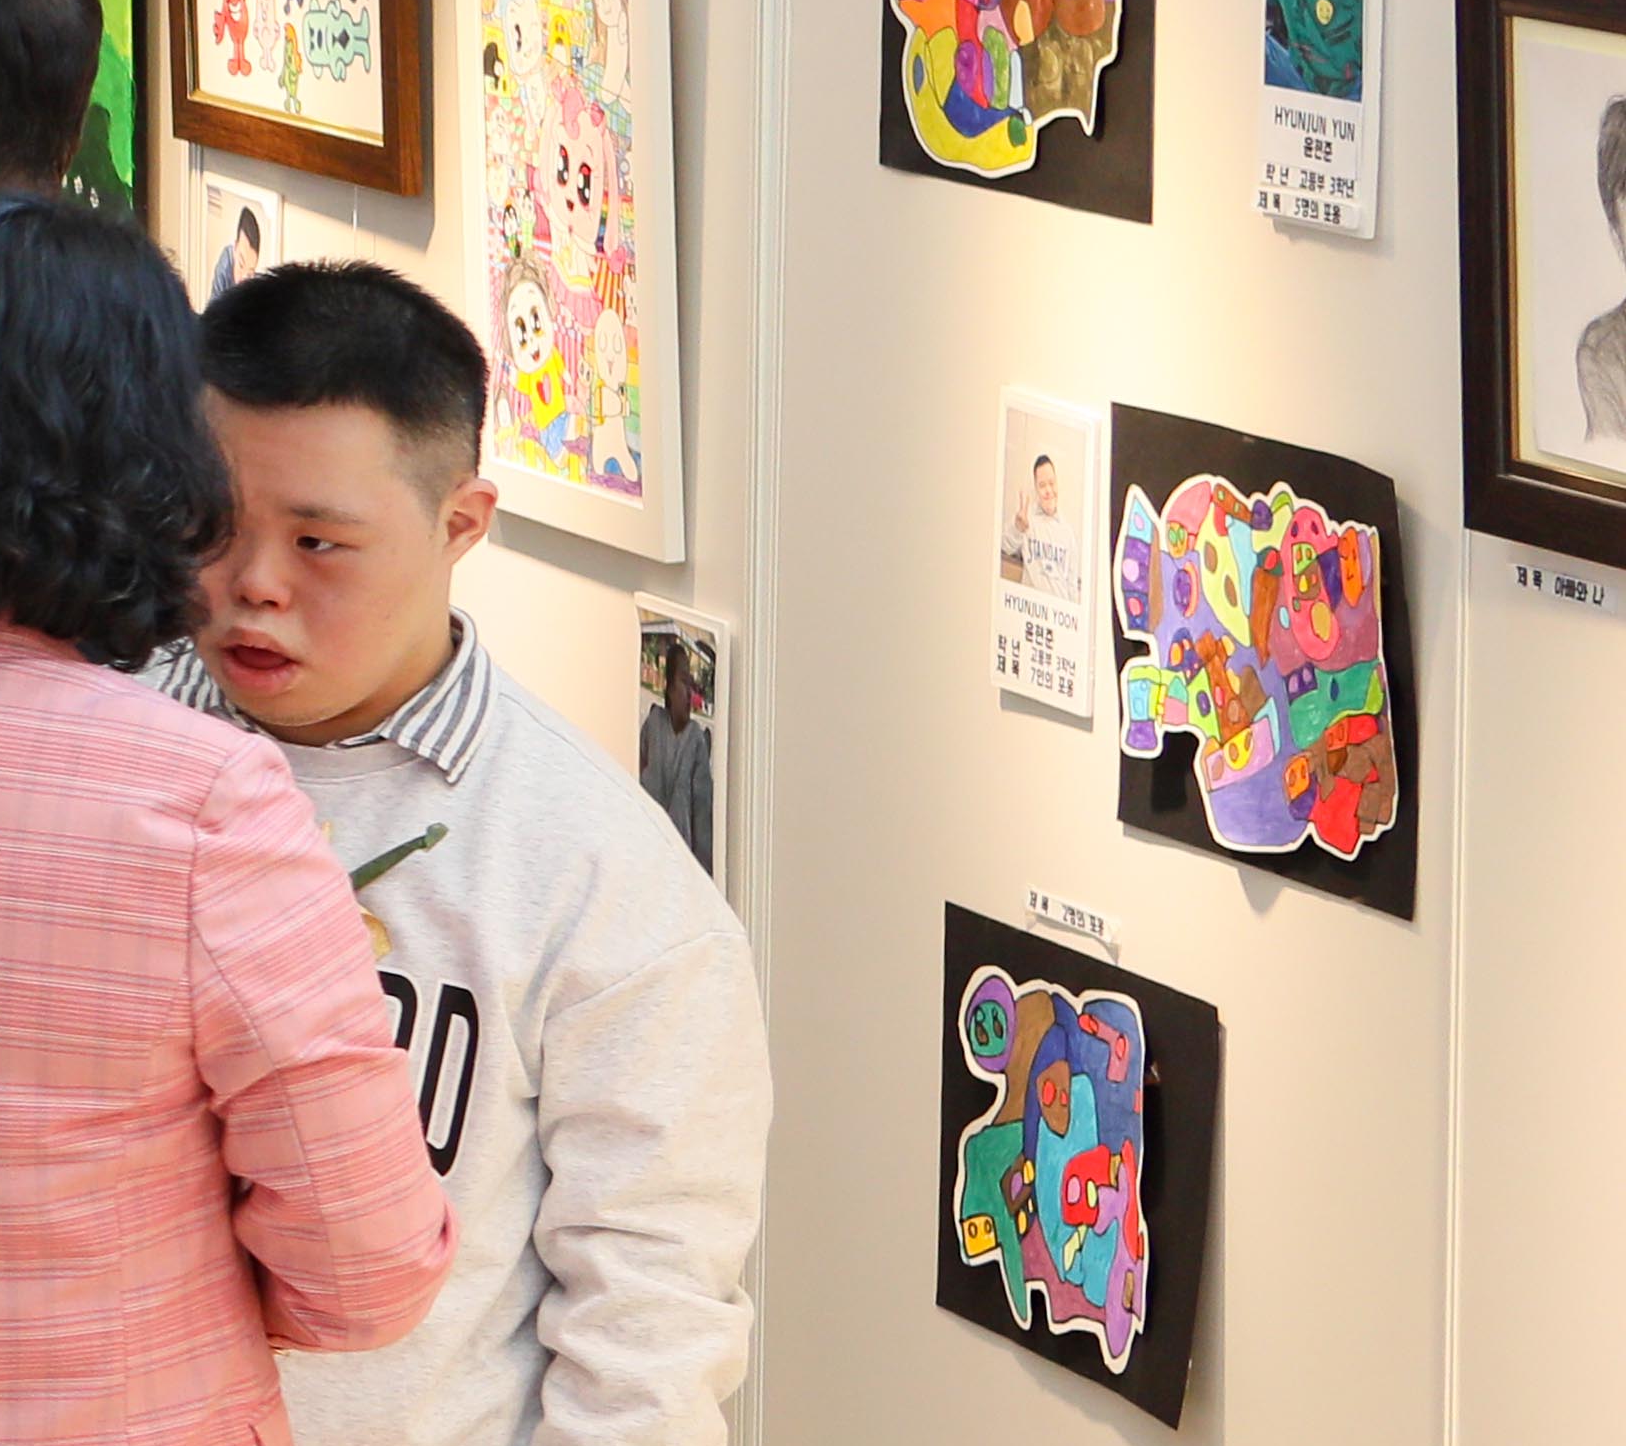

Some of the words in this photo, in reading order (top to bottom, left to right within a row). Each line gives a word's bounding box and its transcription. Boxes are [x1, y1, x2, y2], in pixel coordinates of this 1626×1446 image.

[1274, 105, 1327, 136] HYUNJUN
[1332, 118, 1355, 142] YUN
[1303, 136, 1333, 163] 윤현준
[1294, 197, 1319, 220] 5명의
[1324, 202, 1341, 225] 포옹
[1004, 592, 1048, 621] HYUNJUN
[1052, 609, 1078, 632] YOON
[1025, 621, 1054, 650] 윤현준
[1031, 666, 1053, 690] 7인의
[1058, 675, 1074, 698] 포옹
